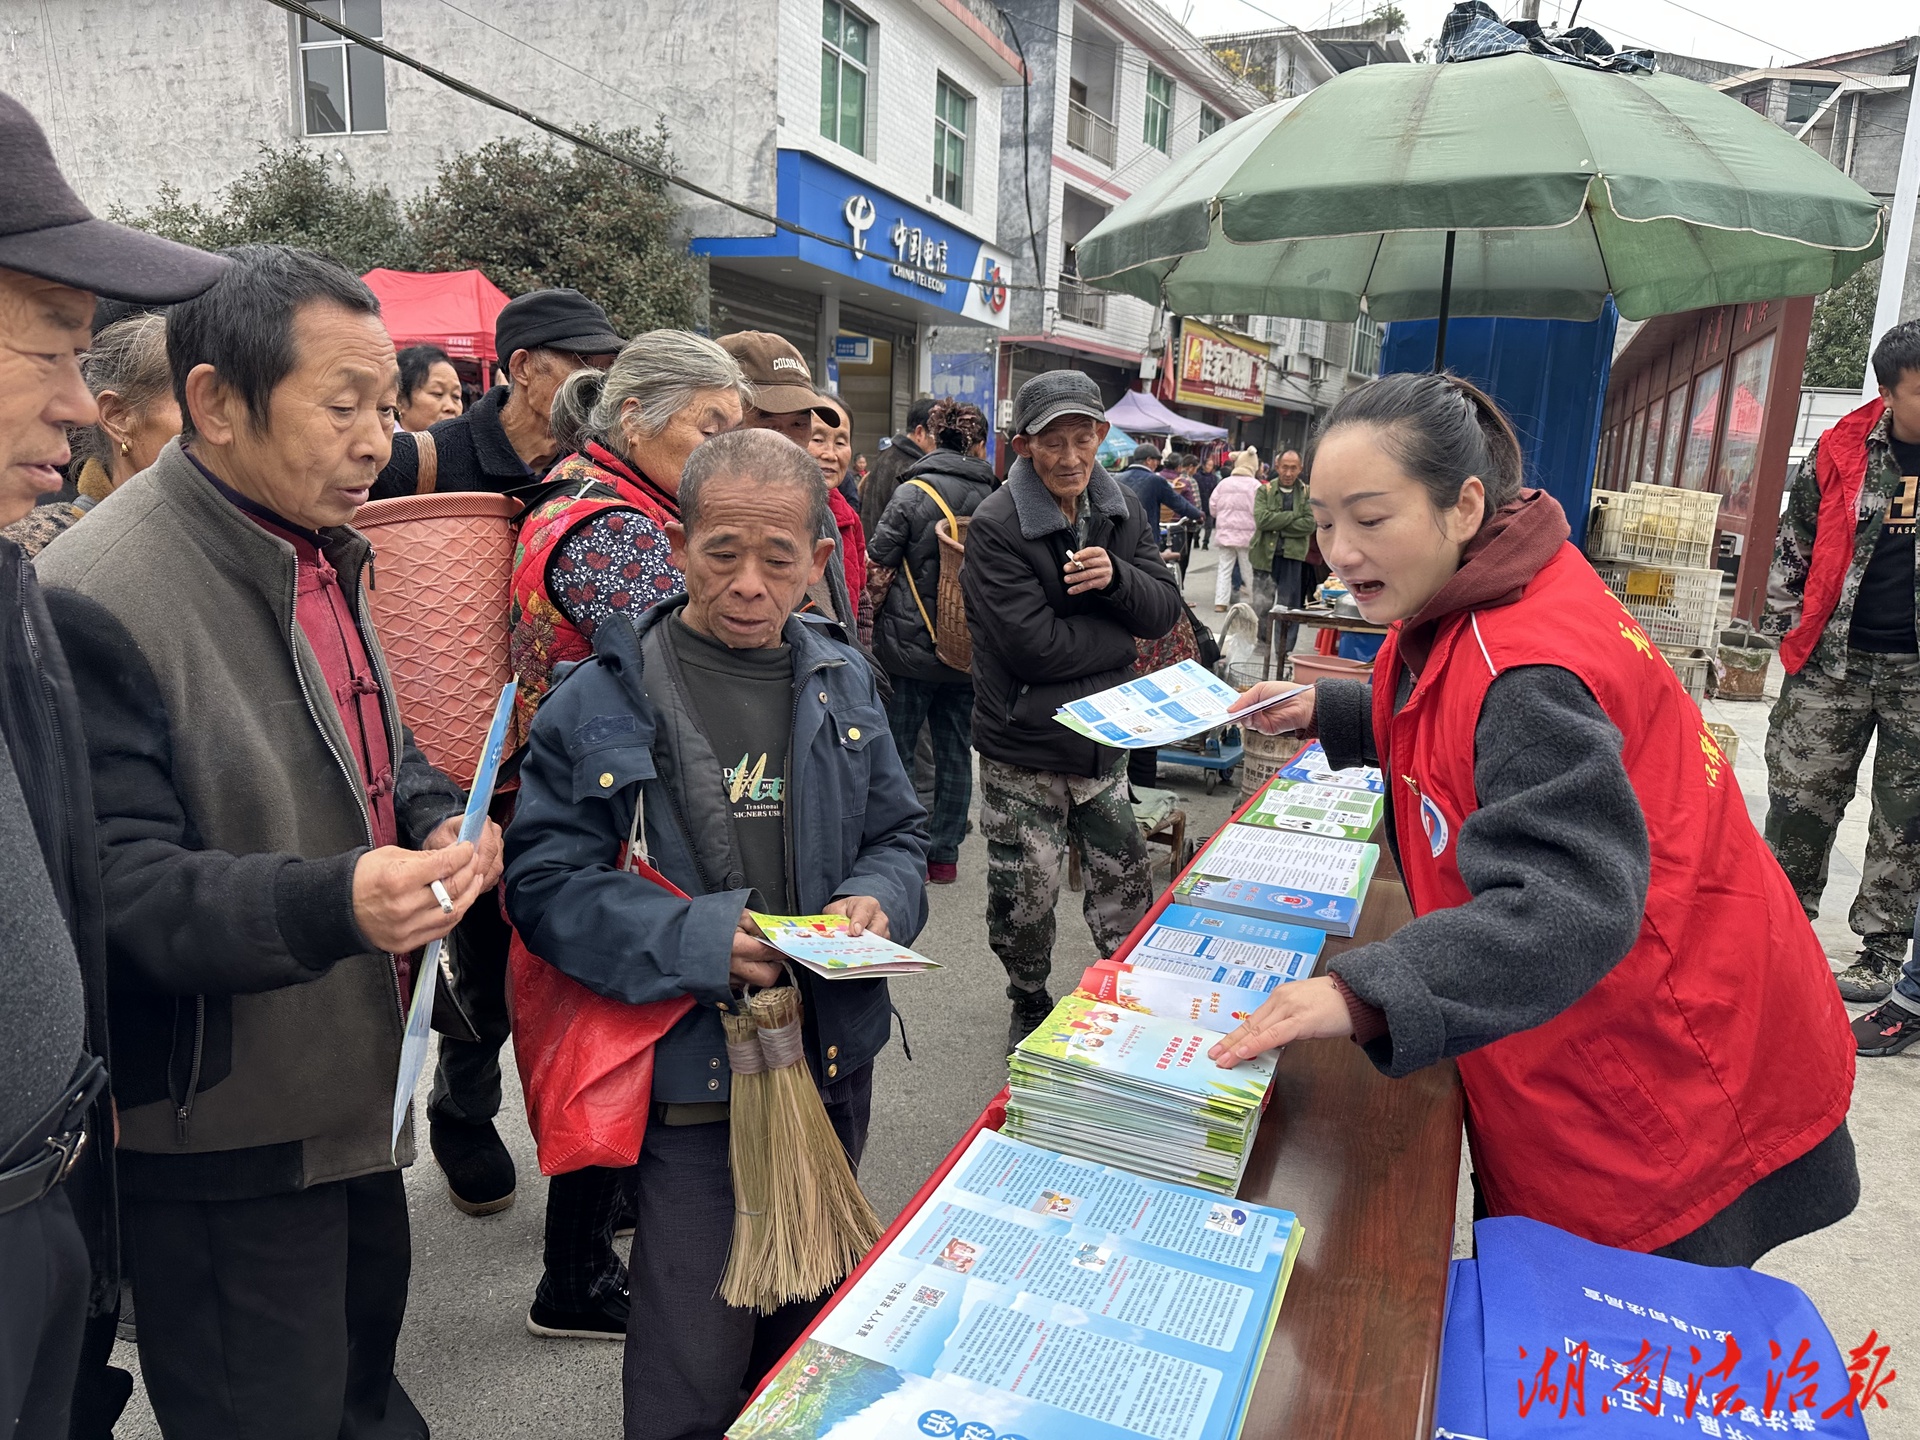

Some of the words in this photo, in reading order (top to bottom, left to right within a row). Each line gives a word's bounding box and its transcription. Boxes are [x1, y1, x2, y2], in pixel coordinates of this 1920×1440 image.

[894, 217, 948, 274] 中国电信
[893, 264, 915, 282] CHINA
[916, 270, 947, 294] TELECOM
[879, 1282, 907, 1308] 守法普法
[855, 1309, 884, 1338] 人人有责
[1582, 1287, 1736, 1343] 龙山县司法局宣
